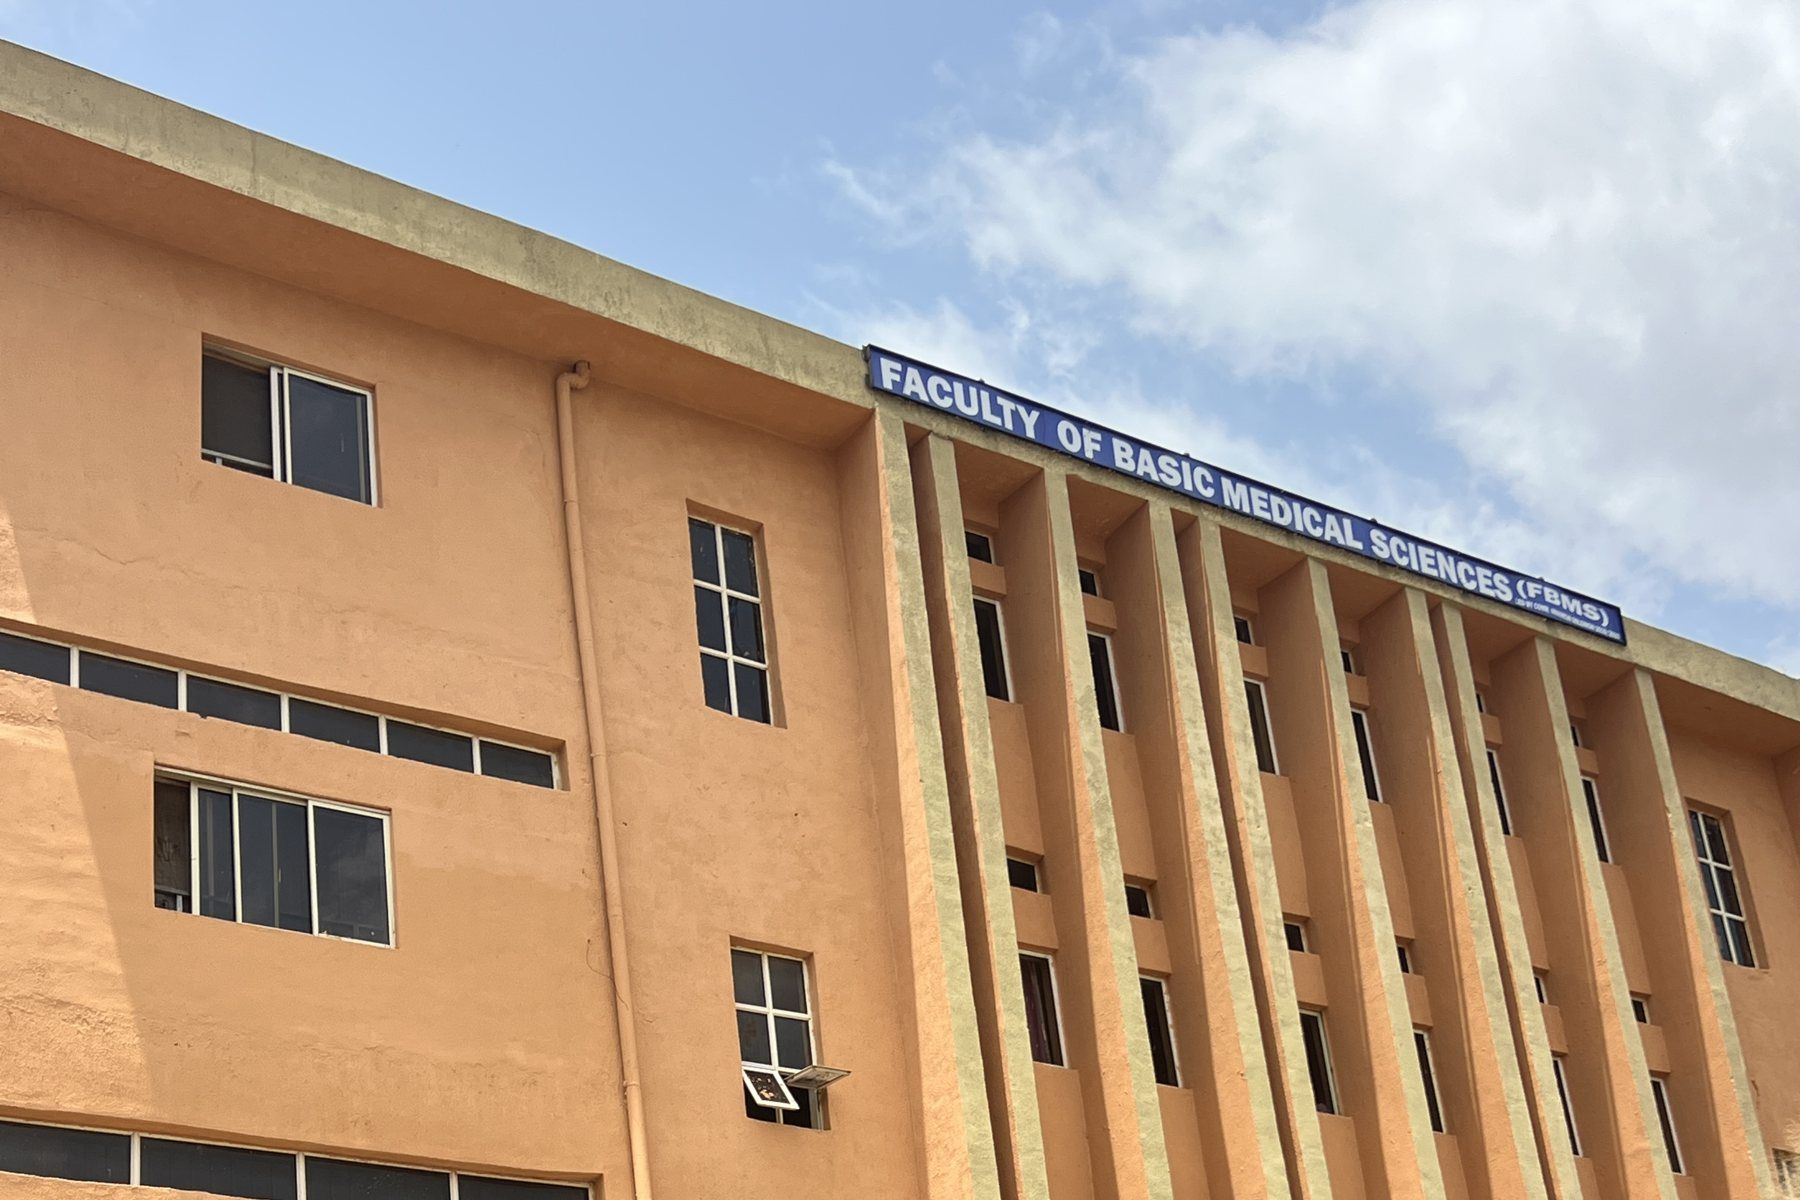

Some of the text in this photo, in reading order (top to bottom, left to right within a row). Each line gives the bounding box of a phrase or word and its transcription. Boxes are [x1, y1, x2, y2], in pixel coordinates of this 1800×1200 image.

[879, 357, 1040, 440] FACULTY
[1056, 419, 1102, 459] OF
[1112, 437, 1216, 498] BASIC
[1220, 476, 1364, 551] MEDICAL
[1370, 528, 1513, 602] SCIENCES
[1516, 579, 1609, 626] (FBMS)
